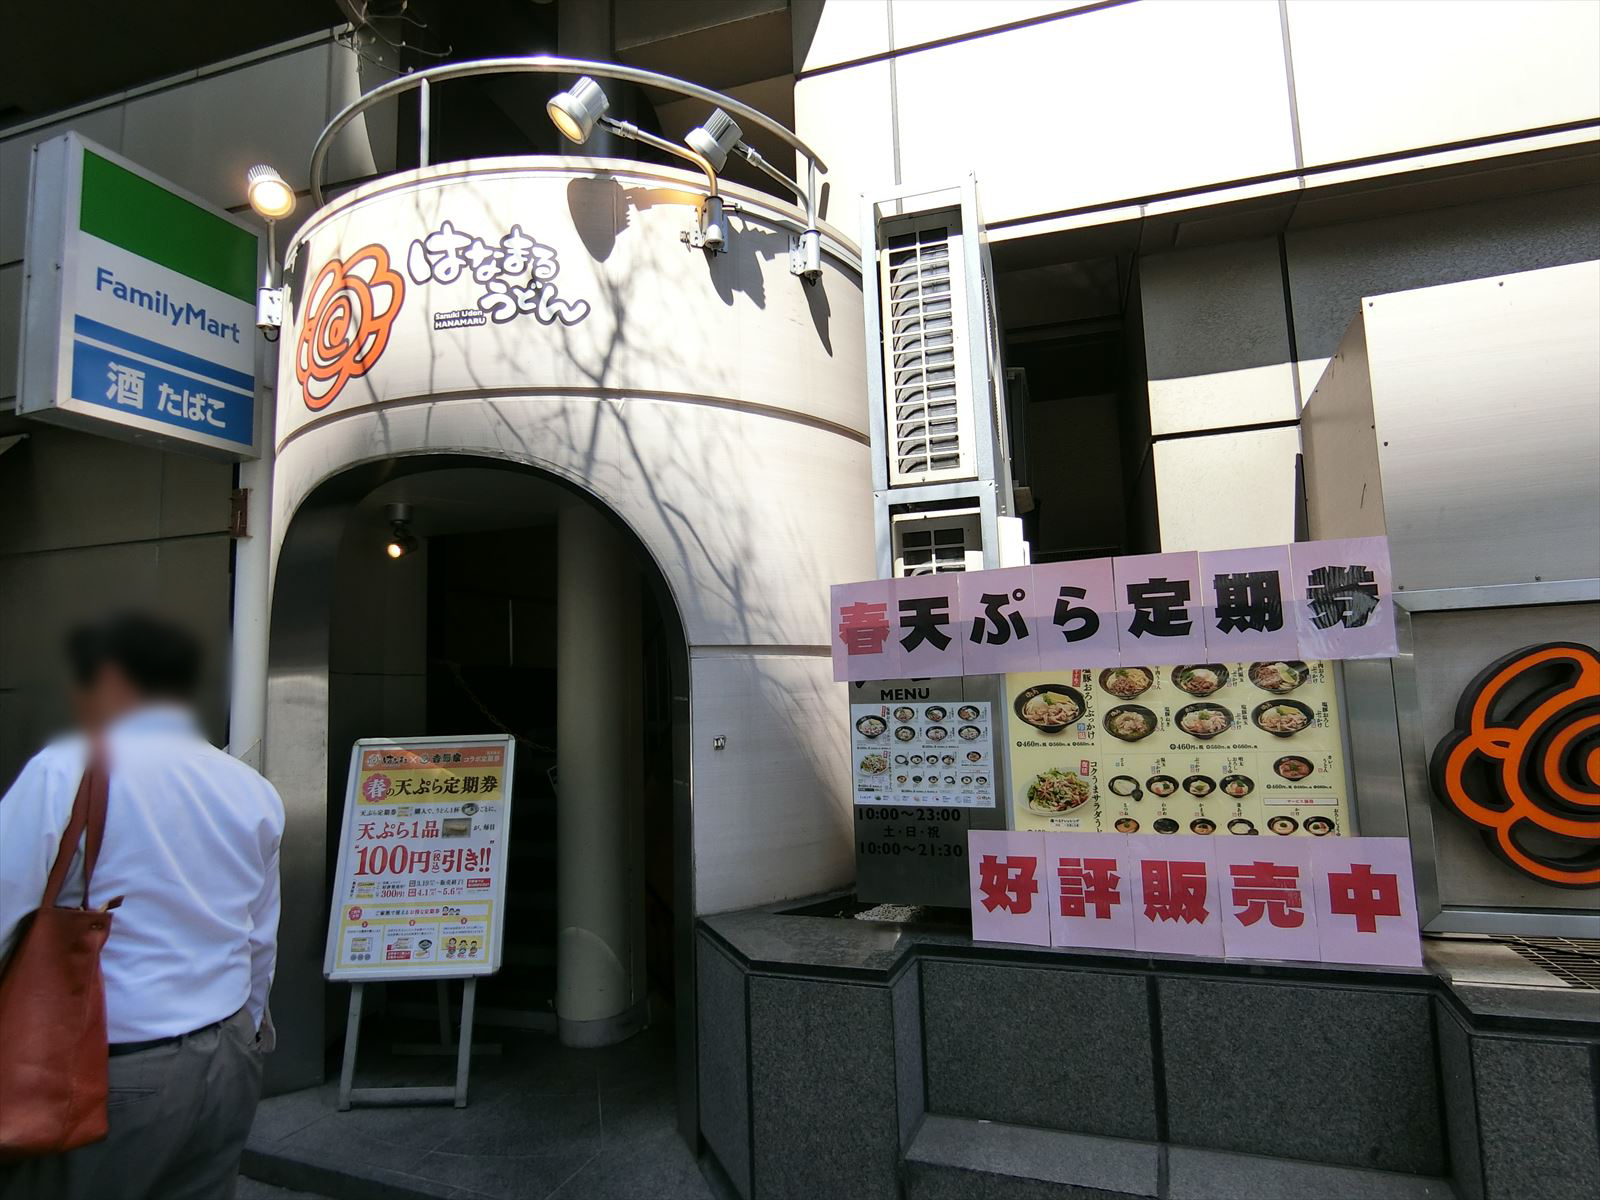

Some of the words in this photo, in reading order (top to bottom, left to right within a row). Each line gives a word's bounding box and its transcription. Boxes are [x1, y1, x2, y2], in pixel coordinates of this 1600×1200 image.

[407, 220, 561, 287] はなまる
[96, 266, 241, 344] FamilyMart
[434, 317, 486, 329] HANAMARU
[435, 312, 460, 320] Sanuki
[461, 309, 483, 317] Udon
[478, 279, 591, 327] うどん
[105, 361, 145, 411] 酒
[157, 381, 228, 429] たばこ
[880, 687, 930, 701] MENU
[356, 820, 440, 841] 天ぷら1品
[979, 854, 1401, 934] 好評販売中
